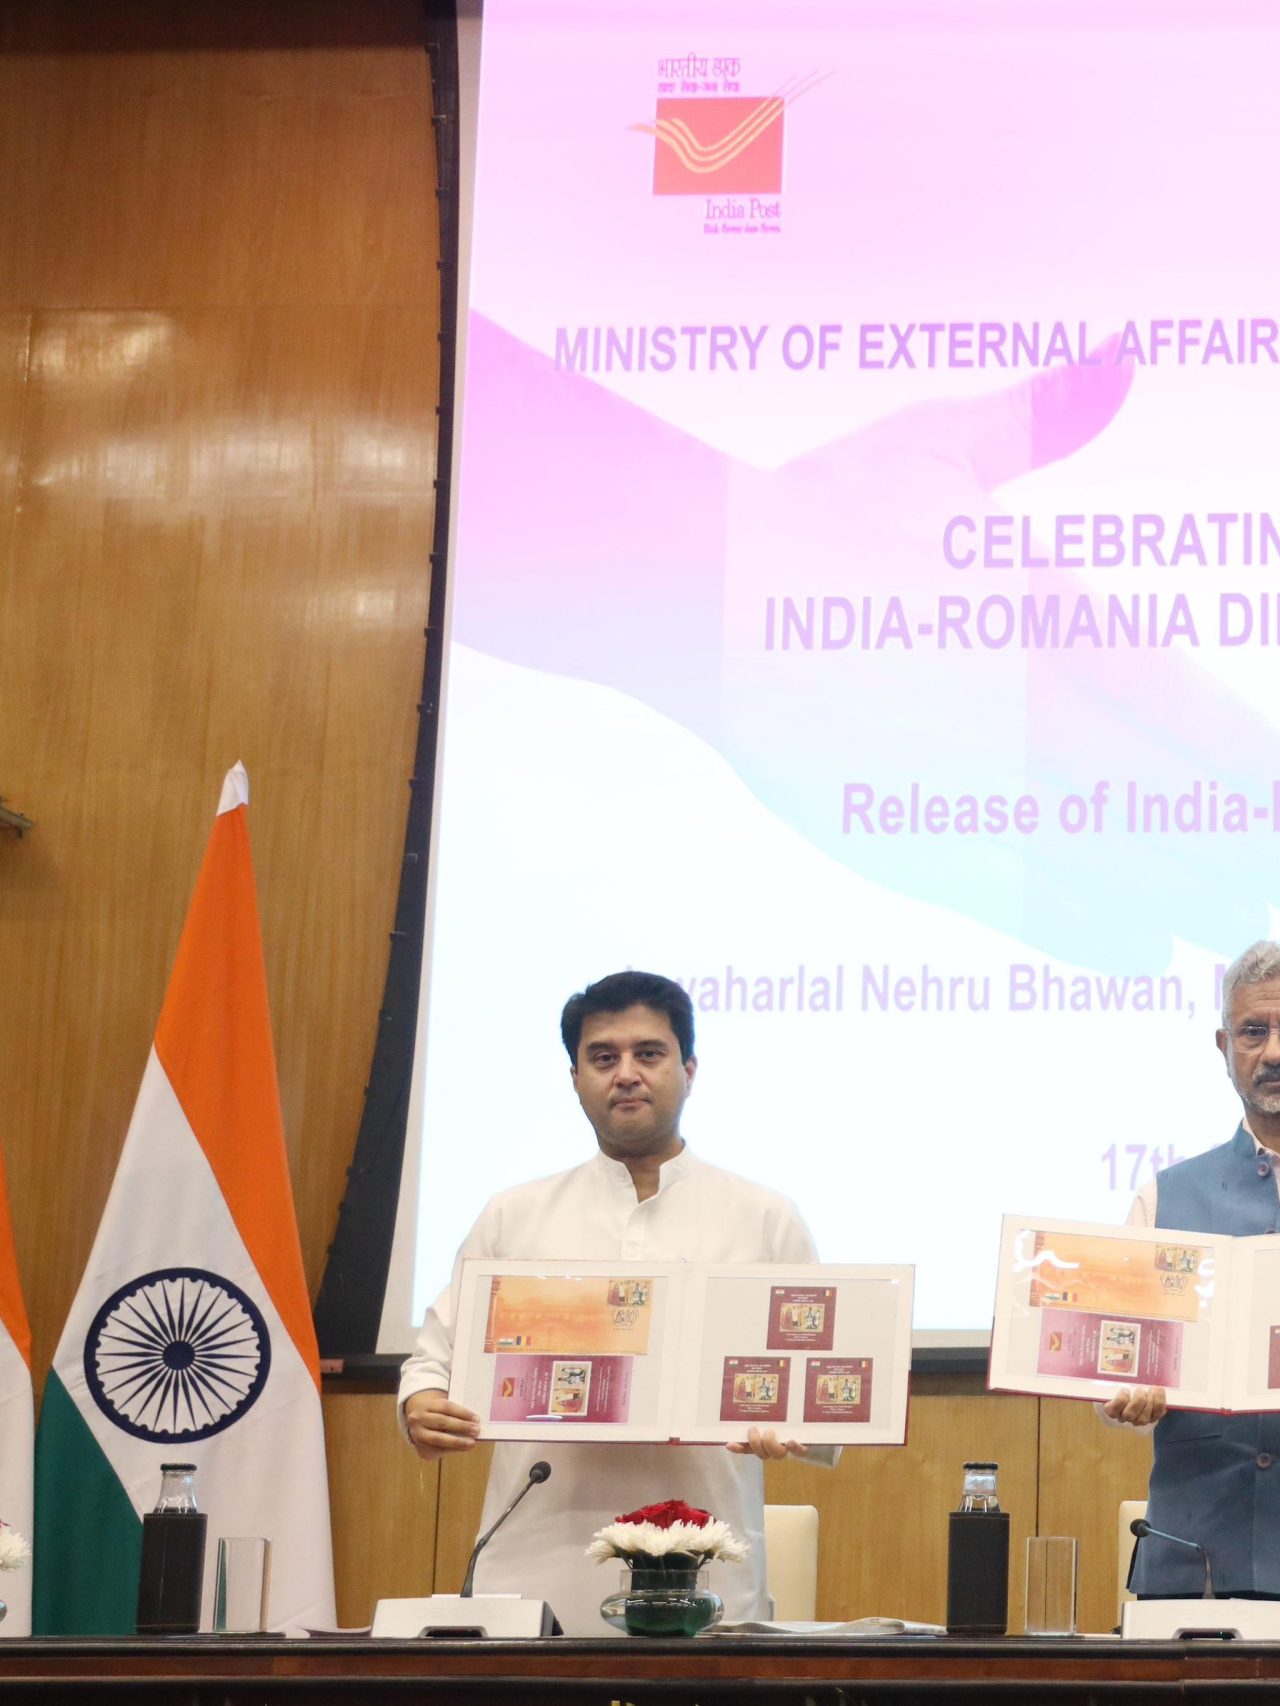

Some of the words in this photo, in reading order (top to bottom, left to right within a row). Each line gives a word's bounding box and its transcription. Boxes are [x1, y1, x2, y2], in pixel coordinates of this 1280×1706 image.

[705, 199, 745, 220] India
[750, 199, 781, 219] Post
[556, 325, 768, 372] MINISTRY
[782, 324, 842, 371] OF
[859, 321, 1101, 369] EXTERNAL
[765, 593, 1200, 650] INDIA-ROMANIA
[843, 783, 1039, 835] Release
[1059, 780, 1110, 834] of
[862, 964, 990, 1012] Nehru
[1009, 964, 1195, 1019] Bhawan,
